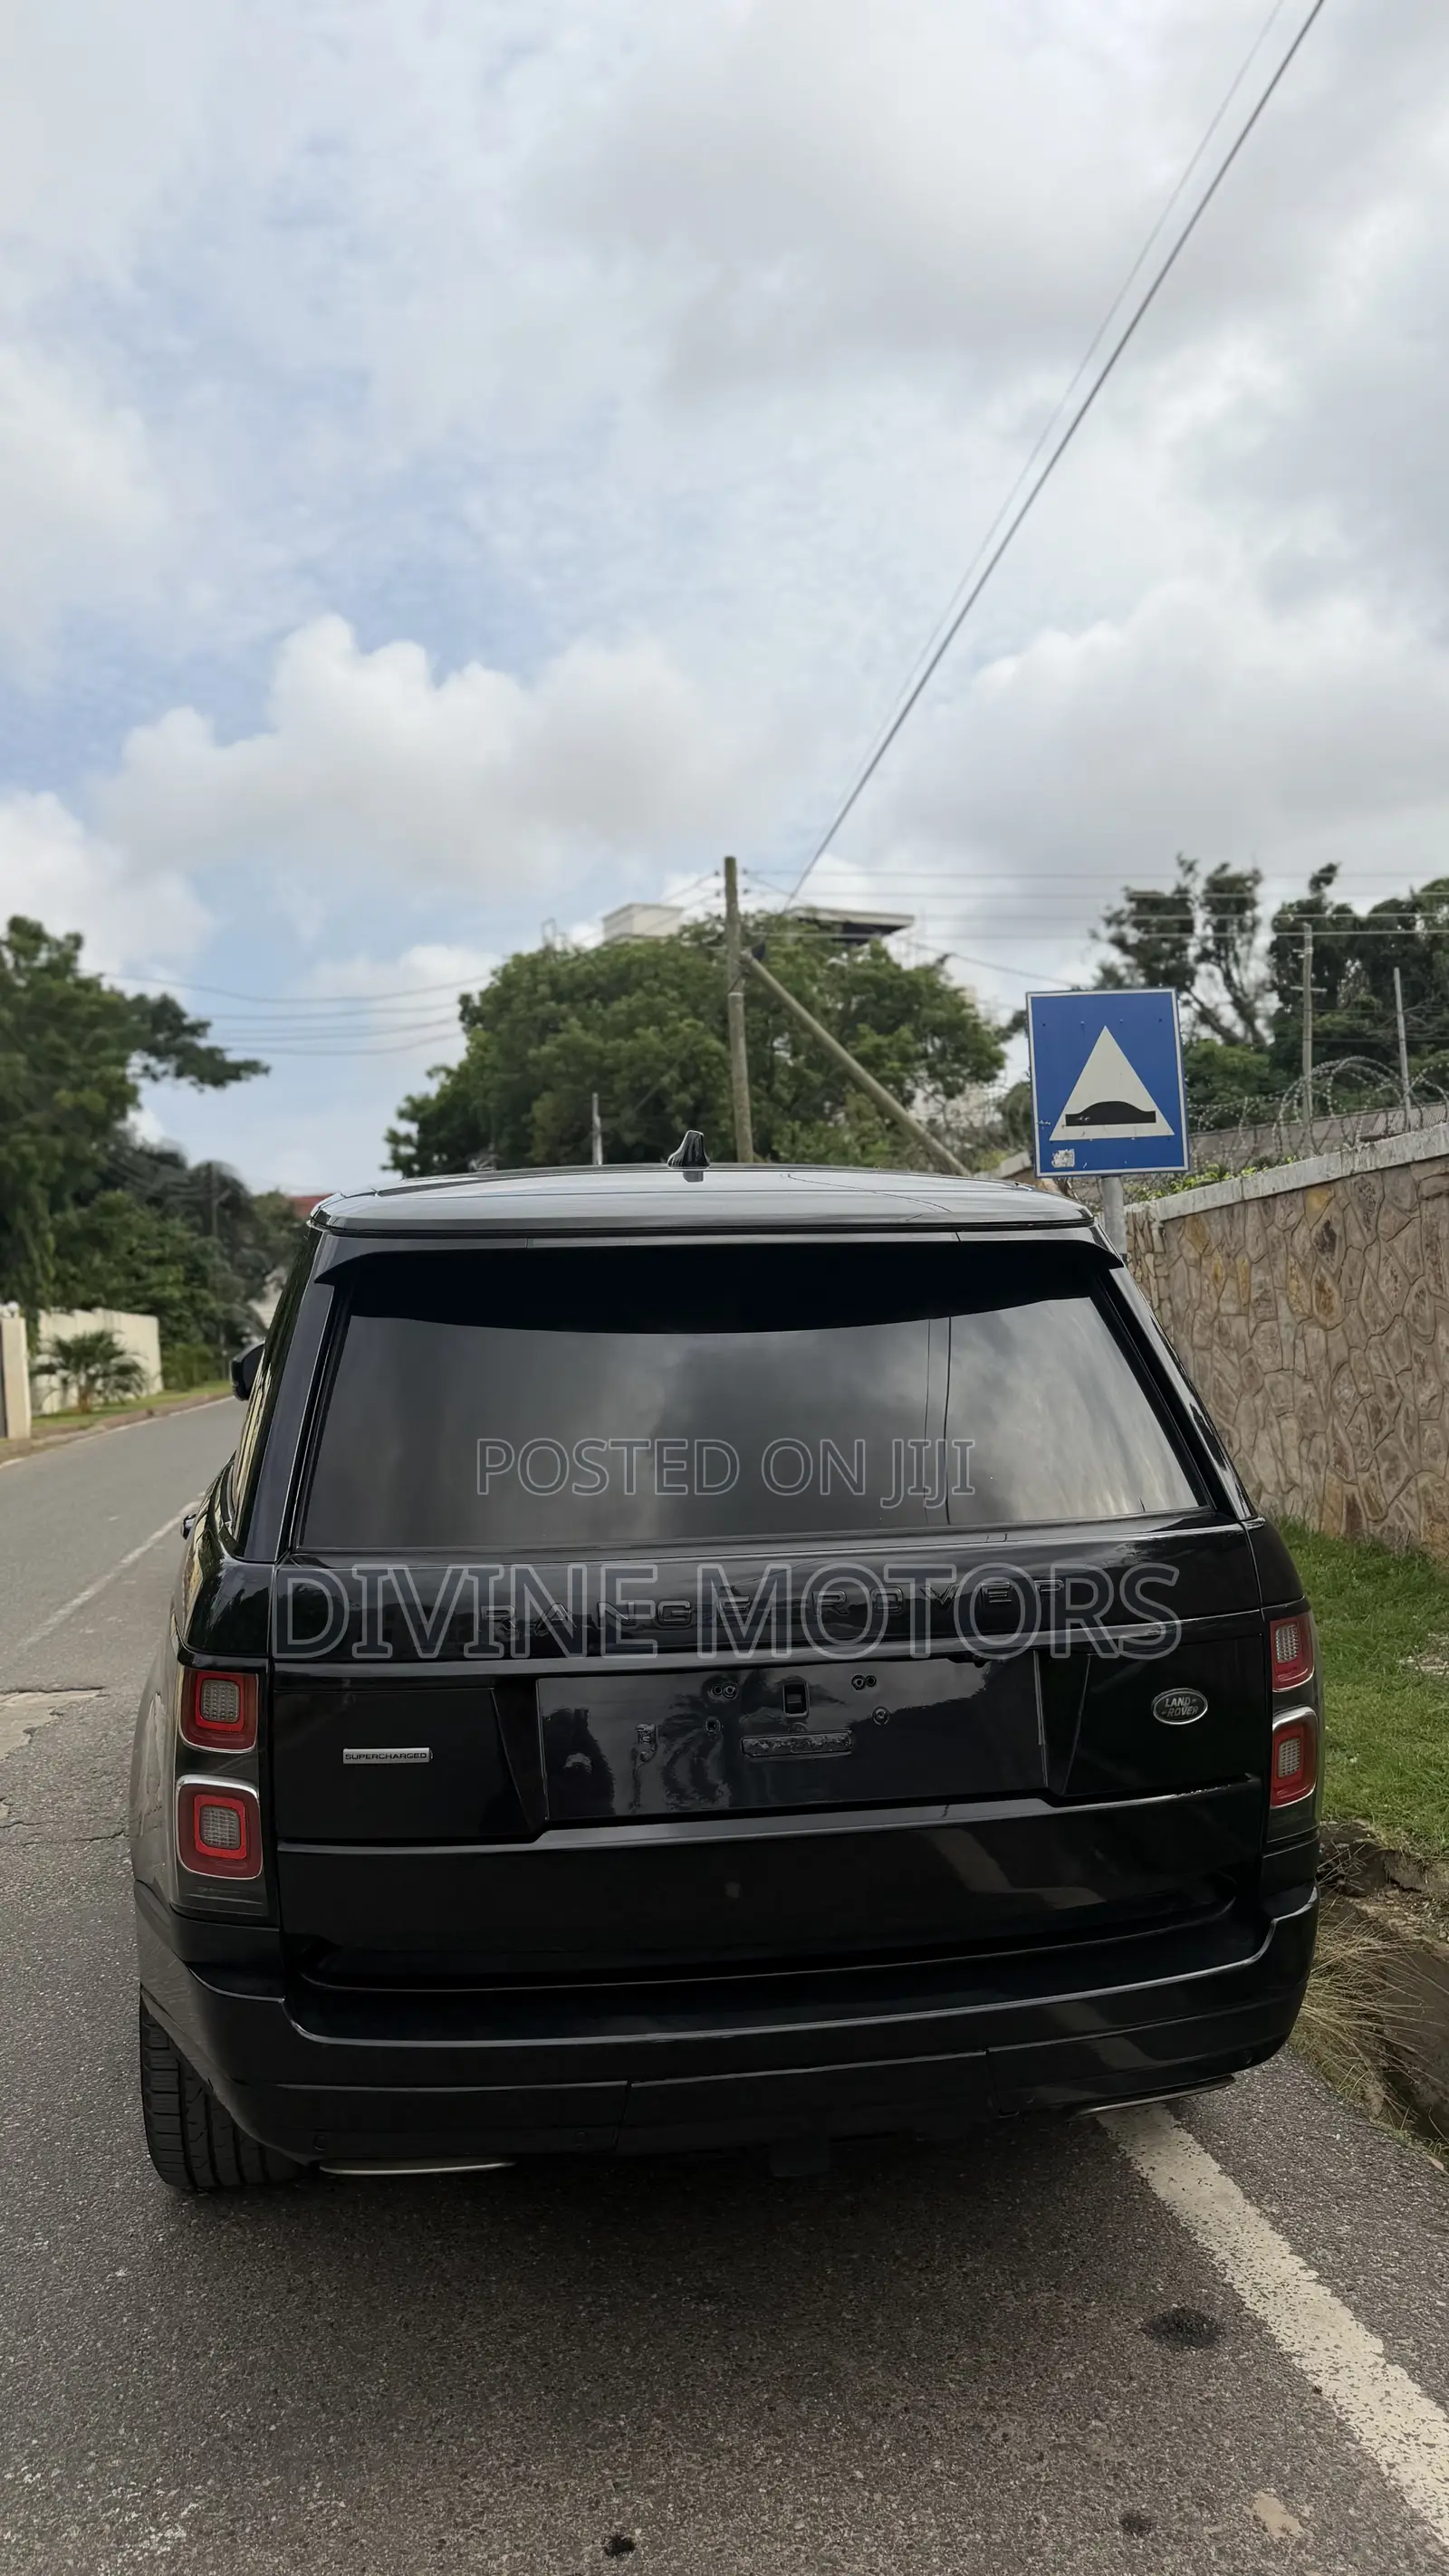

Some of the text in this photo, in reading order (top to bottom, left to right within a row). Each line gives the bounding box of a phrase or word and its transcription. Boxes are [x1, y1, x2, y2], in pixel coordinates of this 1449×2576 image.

[1165, 1697, 1191, 1708] LAND
[1166, 1706, 1199, 1718] ROVER
[344, 1752, 427, 1760] SUPERCHARGED
